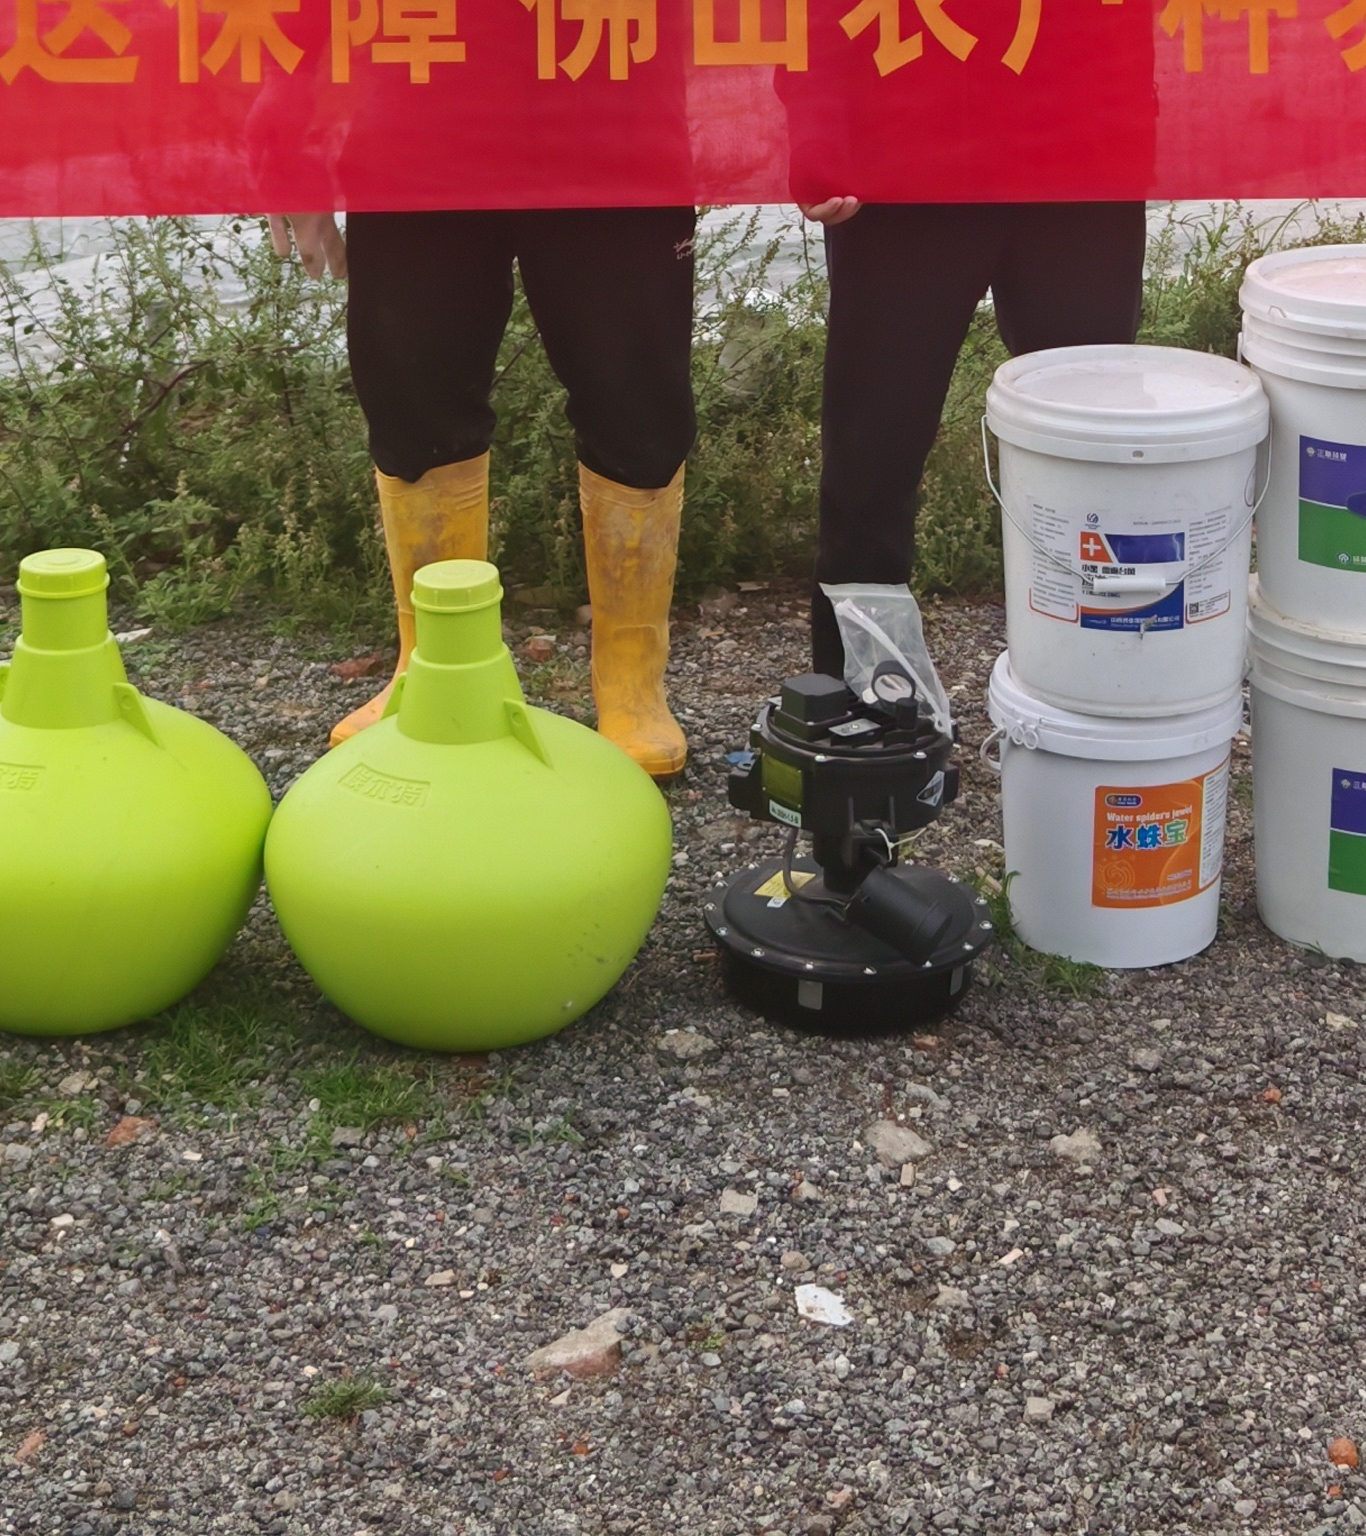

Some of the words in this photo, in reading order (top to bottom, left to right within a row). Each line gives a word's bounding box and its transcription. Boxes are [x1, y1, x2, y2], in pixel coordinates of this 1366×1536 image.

[1106, 811, 1134, 822] Water
[1171, 805, 1193, 820] jewel
[1105, 818, 1189, 851] 水蛛宝
